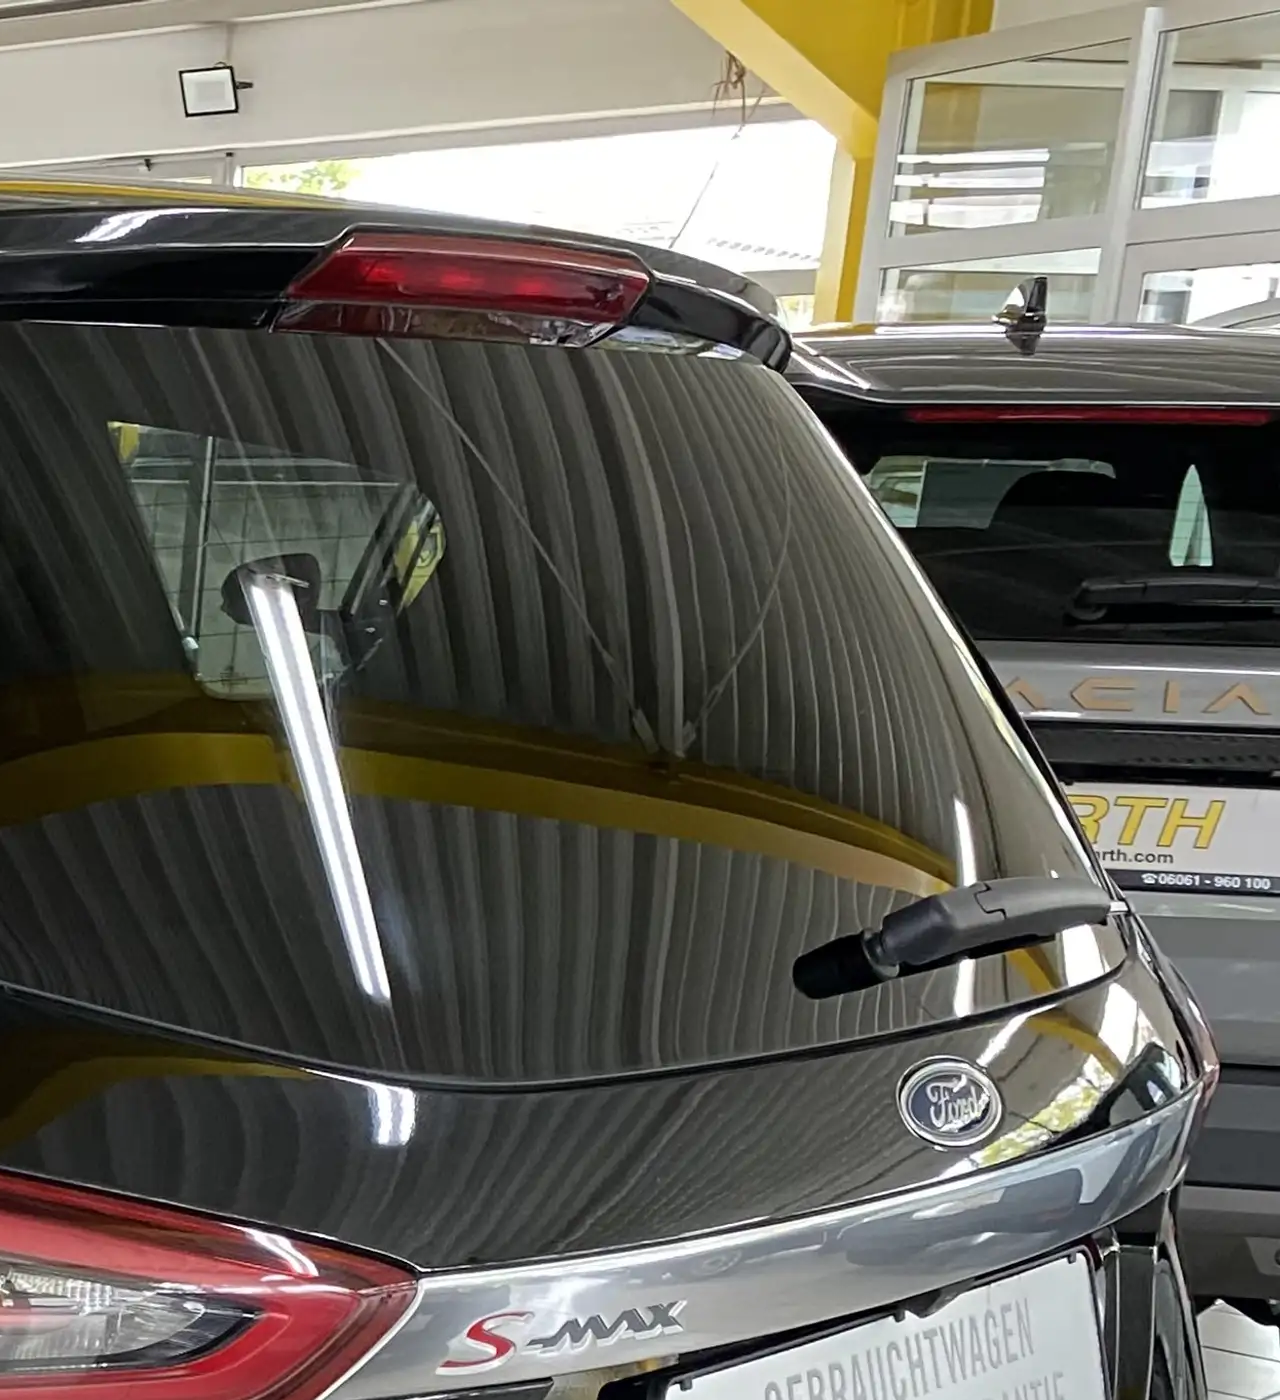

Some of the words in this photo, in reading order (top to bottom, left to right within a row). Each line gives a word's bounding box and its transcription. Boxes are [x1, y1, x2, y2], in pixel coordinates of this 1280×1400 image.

[1004, 677, 1272, 715] ACIA
[1066, 794, 1226, 849] RTH
[1097, 849, 1175, 864] rth.com
[1158, 873, 1200, 887] 06061
[1214, 876, 1240, 888] 960
[1245, 877, 1271, 890] 100
[925, 1076, 985, 1129] Ford
